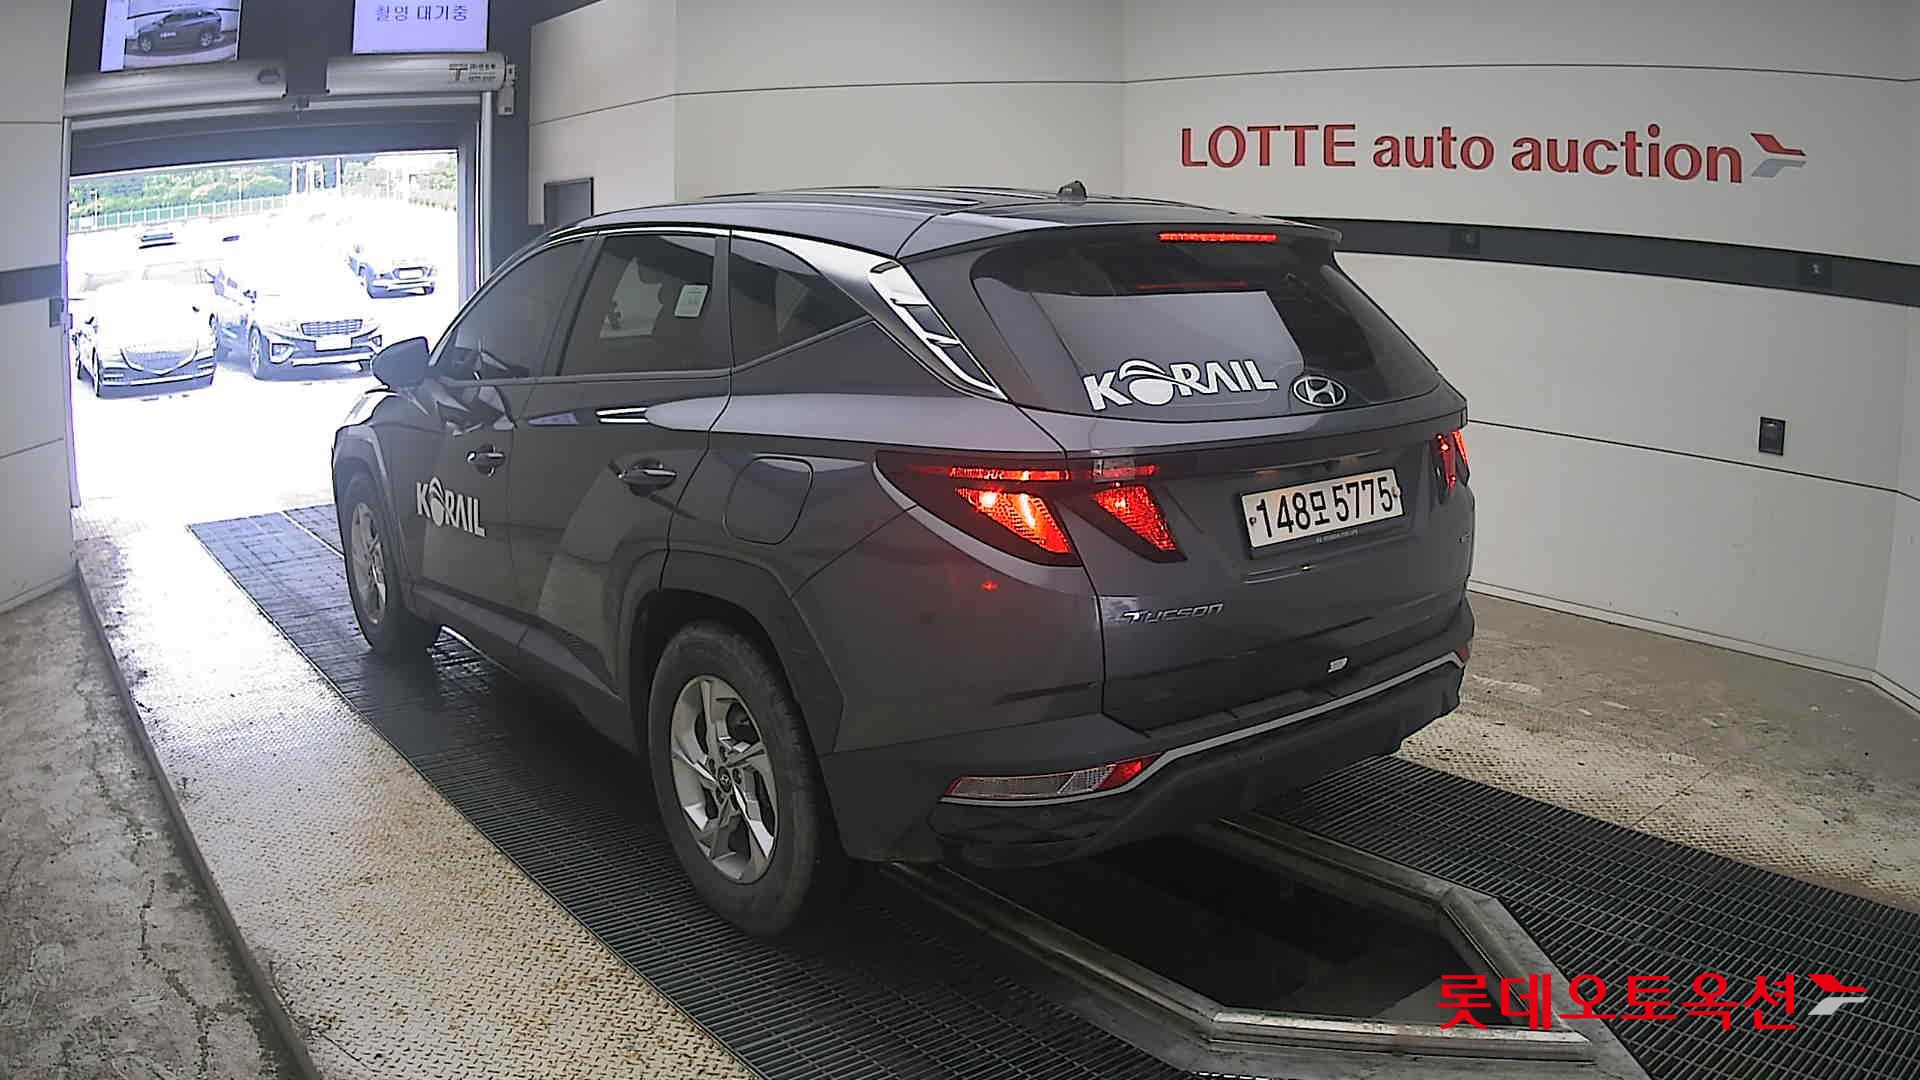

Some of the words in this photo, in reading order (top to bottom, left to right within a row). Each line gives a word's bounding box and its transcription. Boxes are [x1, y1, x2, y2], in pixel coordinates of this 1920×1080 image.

[416, 4, 468, 21] 대기중
[1181, 124, 1356, 168] LOTTE
[1373, 126, 1495, 169] auto
[1511, 123, 1742, 183] auction
[1083, 359, 1278, 411] KORAIL
[416, 476, 485, 537] KORAIL
[1122, 601, 1224, 624] TUCSON
